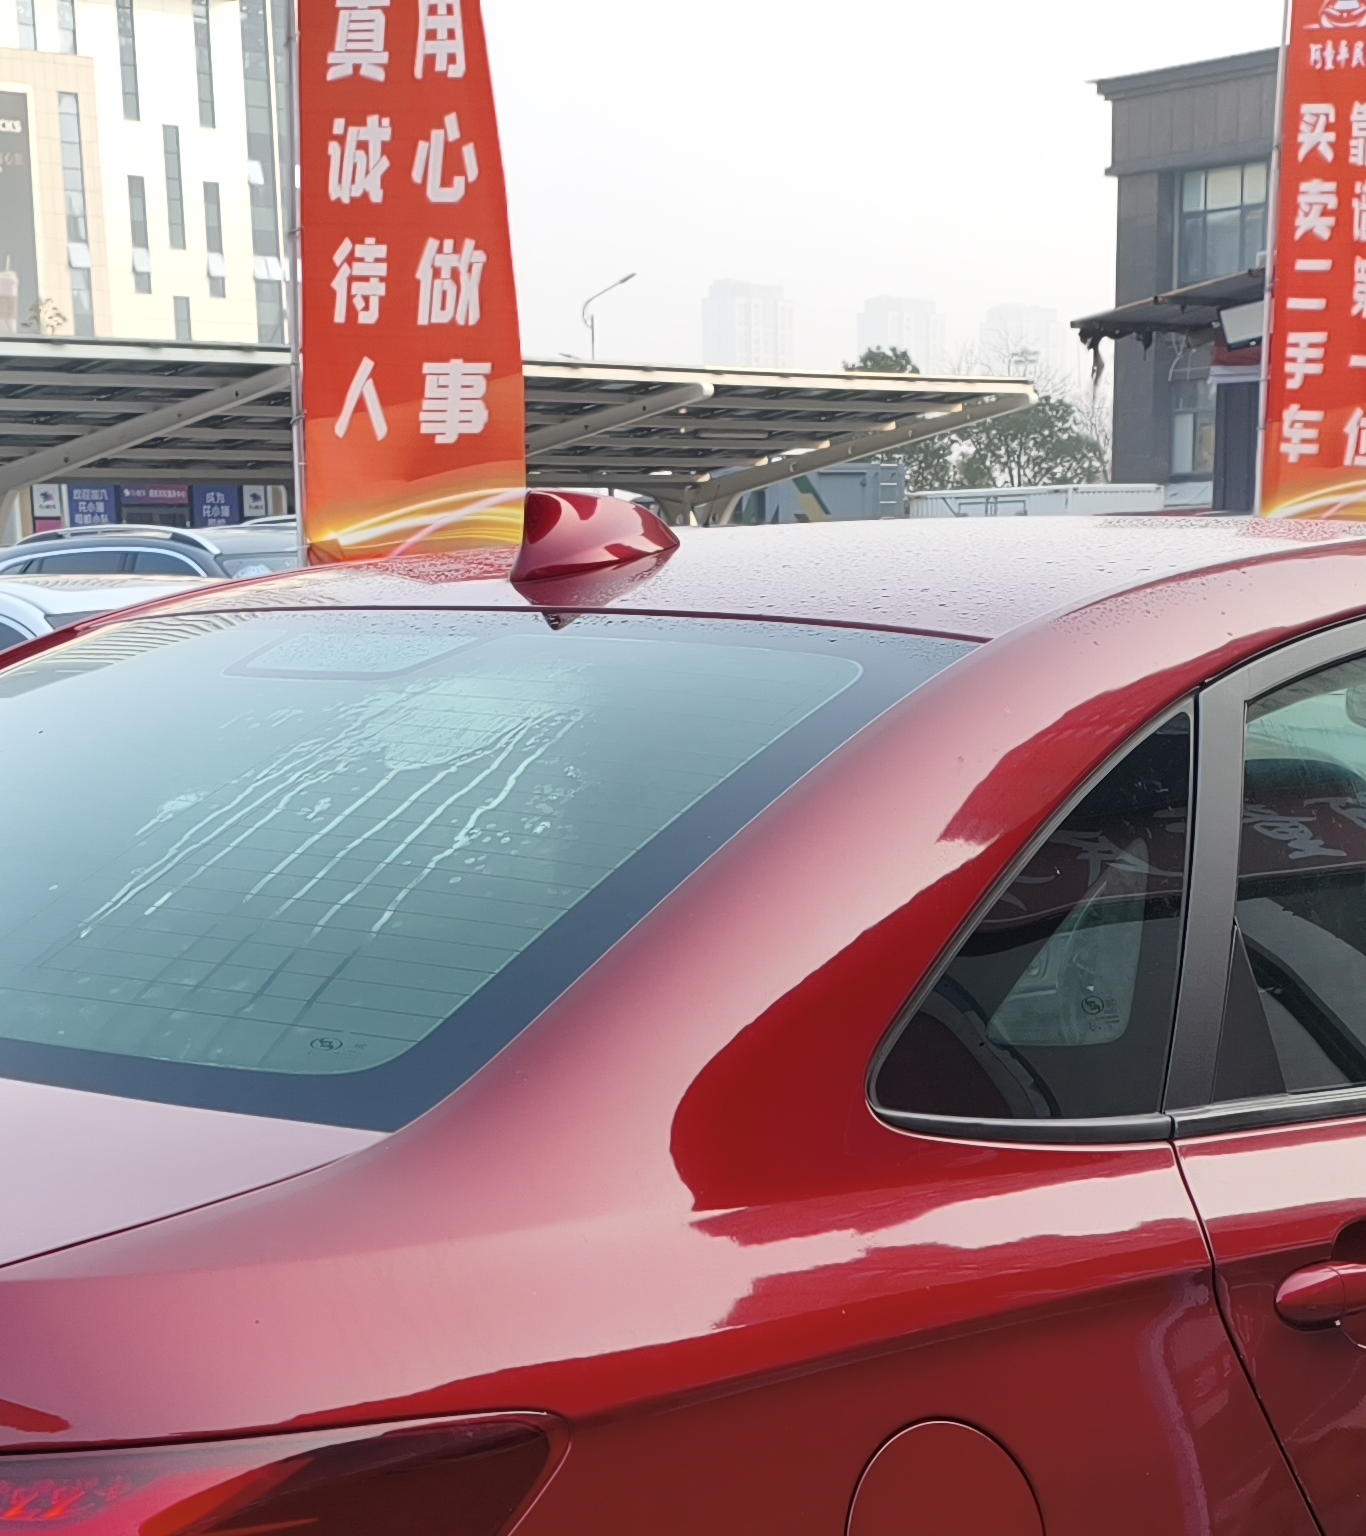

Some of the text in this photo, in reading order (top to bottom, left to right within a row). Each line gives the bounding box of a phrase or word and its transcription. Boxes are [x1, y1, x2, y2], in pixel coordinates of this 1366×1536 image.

[326, 0, 392, 442] 真诚待人
[411, 0, 492, 444] 用心做事
[1279, 103, 1337, 464] 买卖二手车
